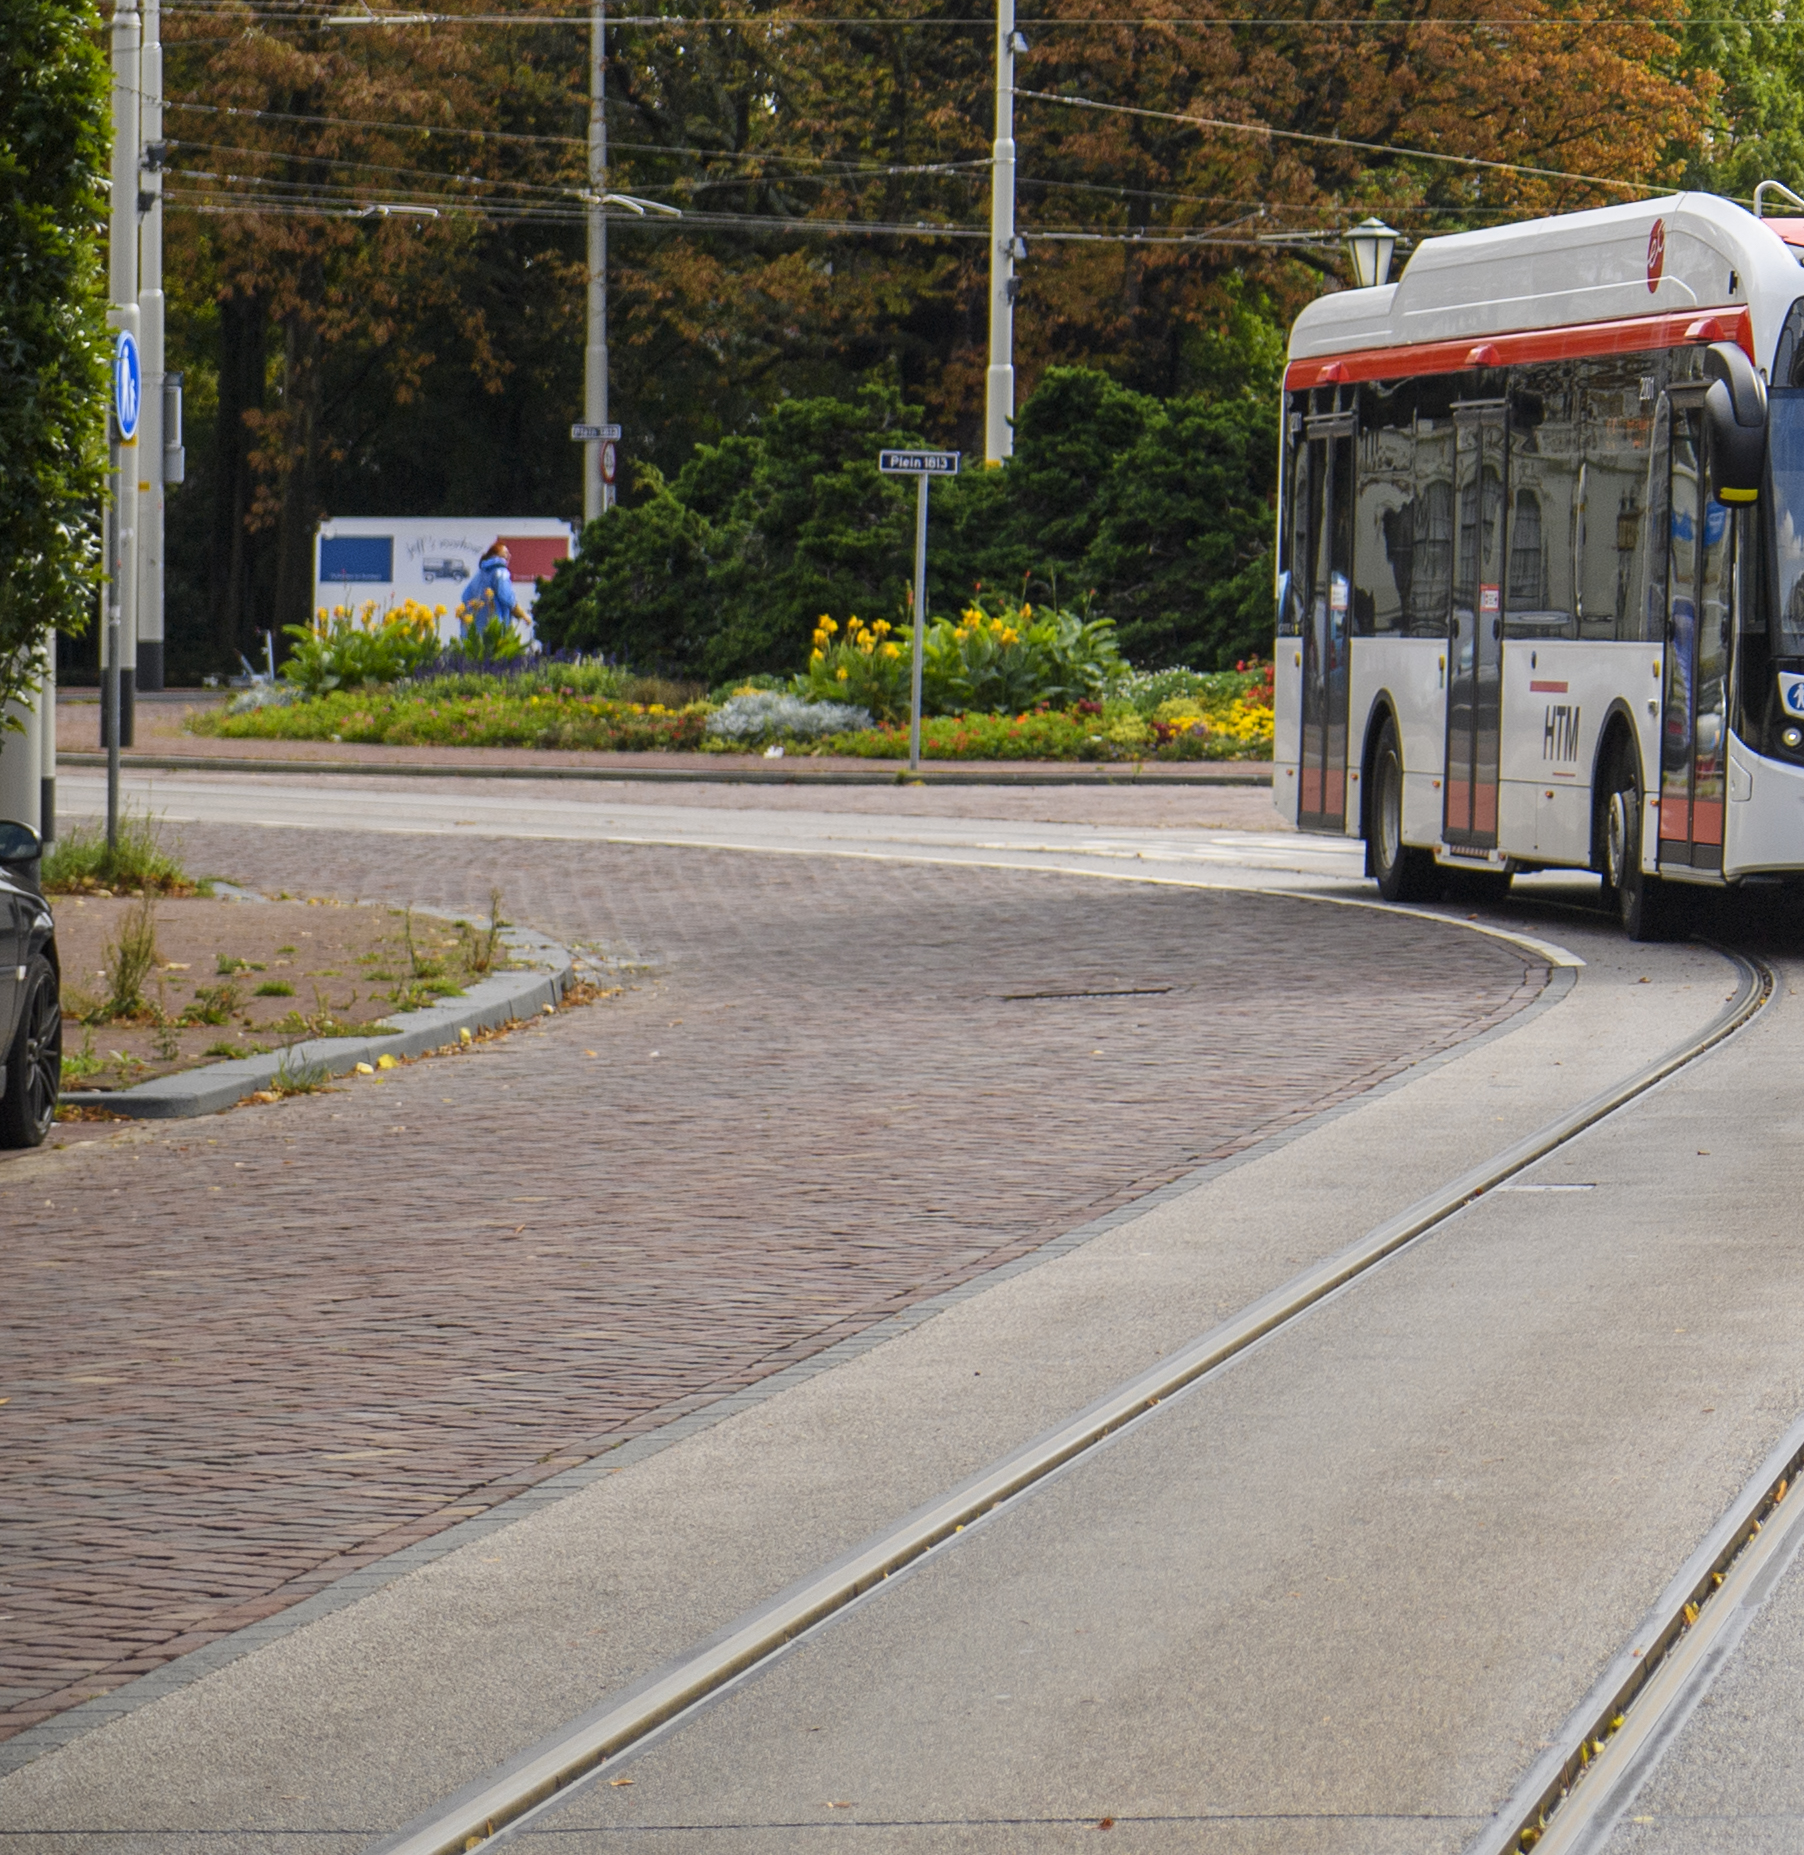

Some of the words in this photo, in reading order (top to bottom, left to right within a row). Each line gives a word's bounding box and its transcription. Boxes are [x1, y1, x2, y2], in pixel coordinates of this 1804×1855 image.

[890, 455, 922, 468] Plein
[924, 456, 948, 469] 1813
[1543, 705, 1581, 762] HTM
